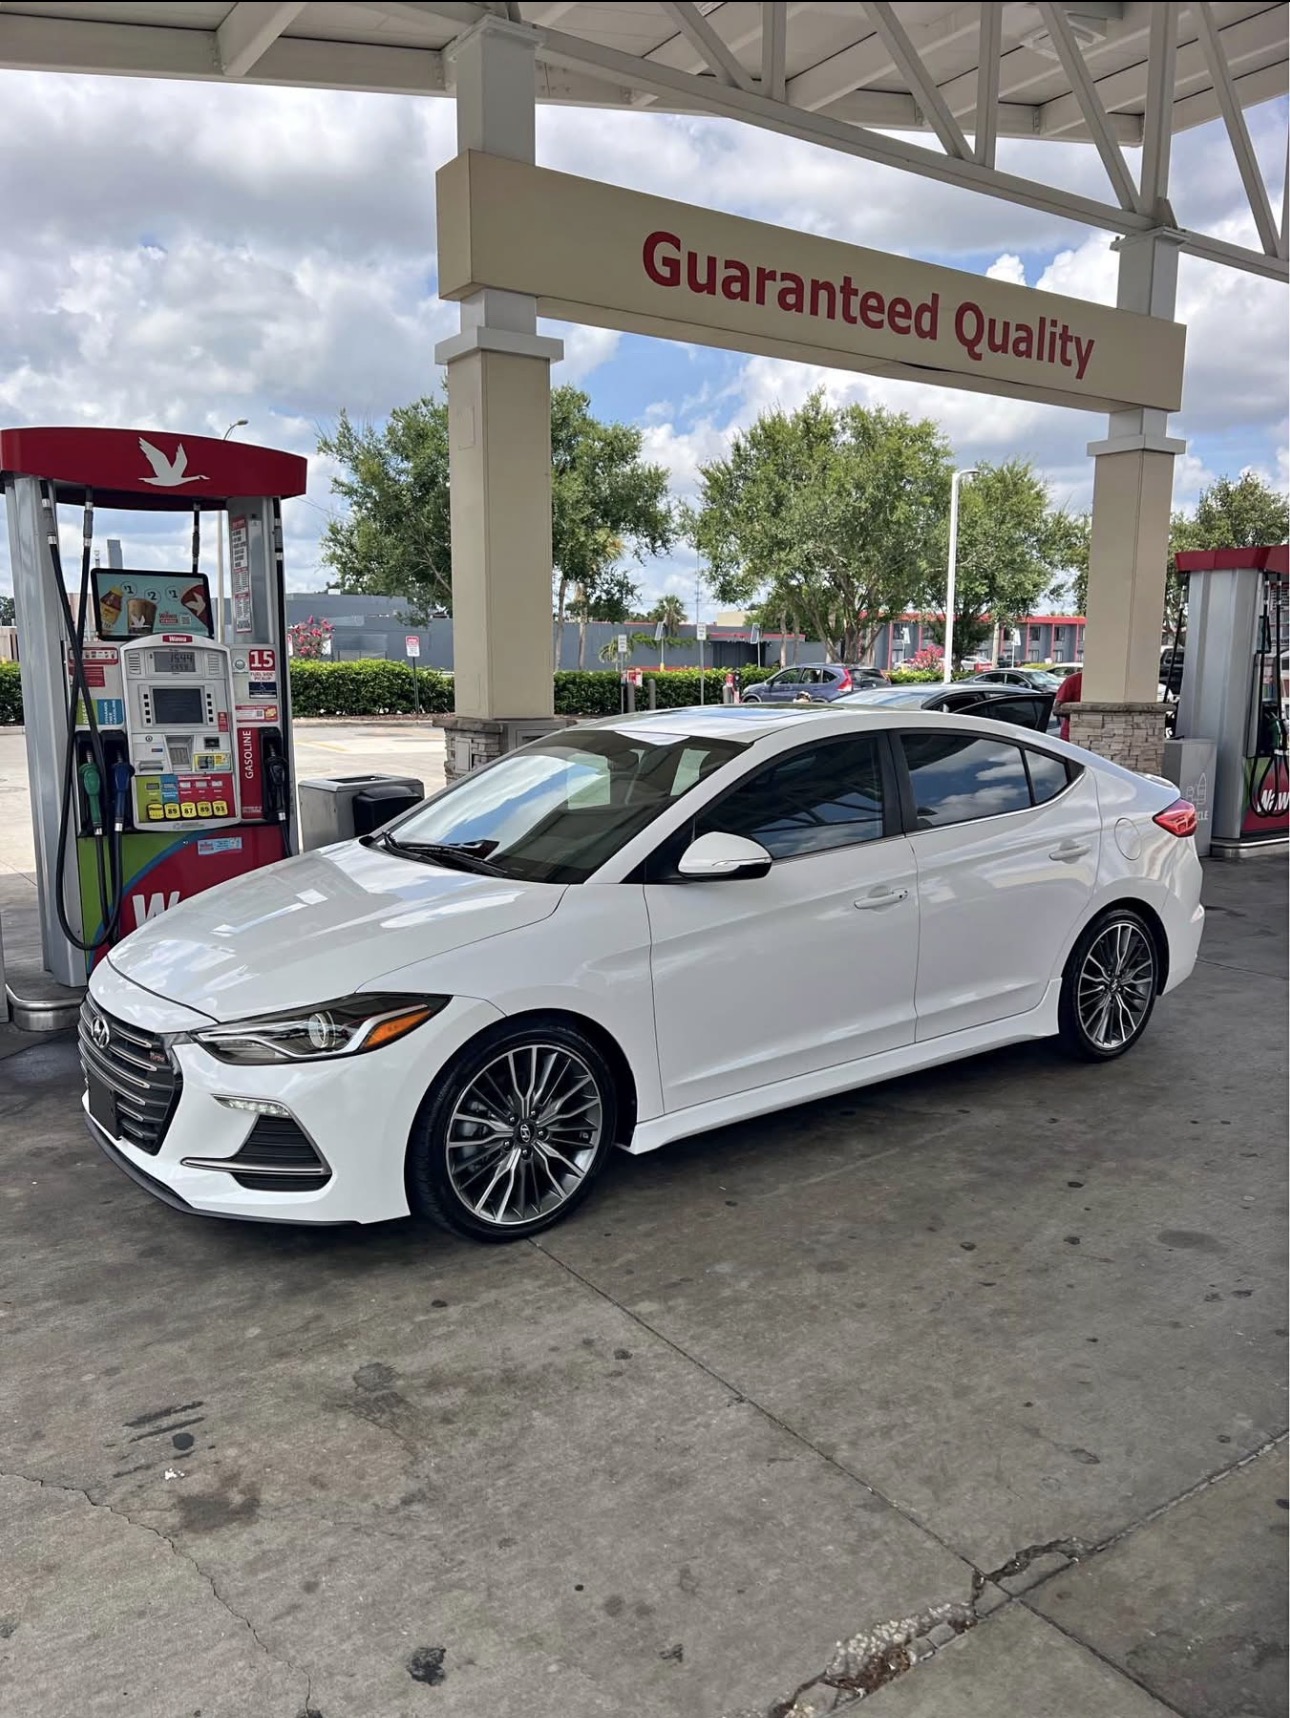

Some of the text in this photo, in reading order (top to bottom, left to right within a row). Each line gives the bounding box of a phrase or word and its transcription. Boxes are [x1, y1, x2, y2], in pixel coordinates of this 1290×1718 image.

[642, 231, 1096, 380] Guaranteed Quality
[250, 651, 274, 668] 15
[242, 730, 254, 779] GASOLINE
